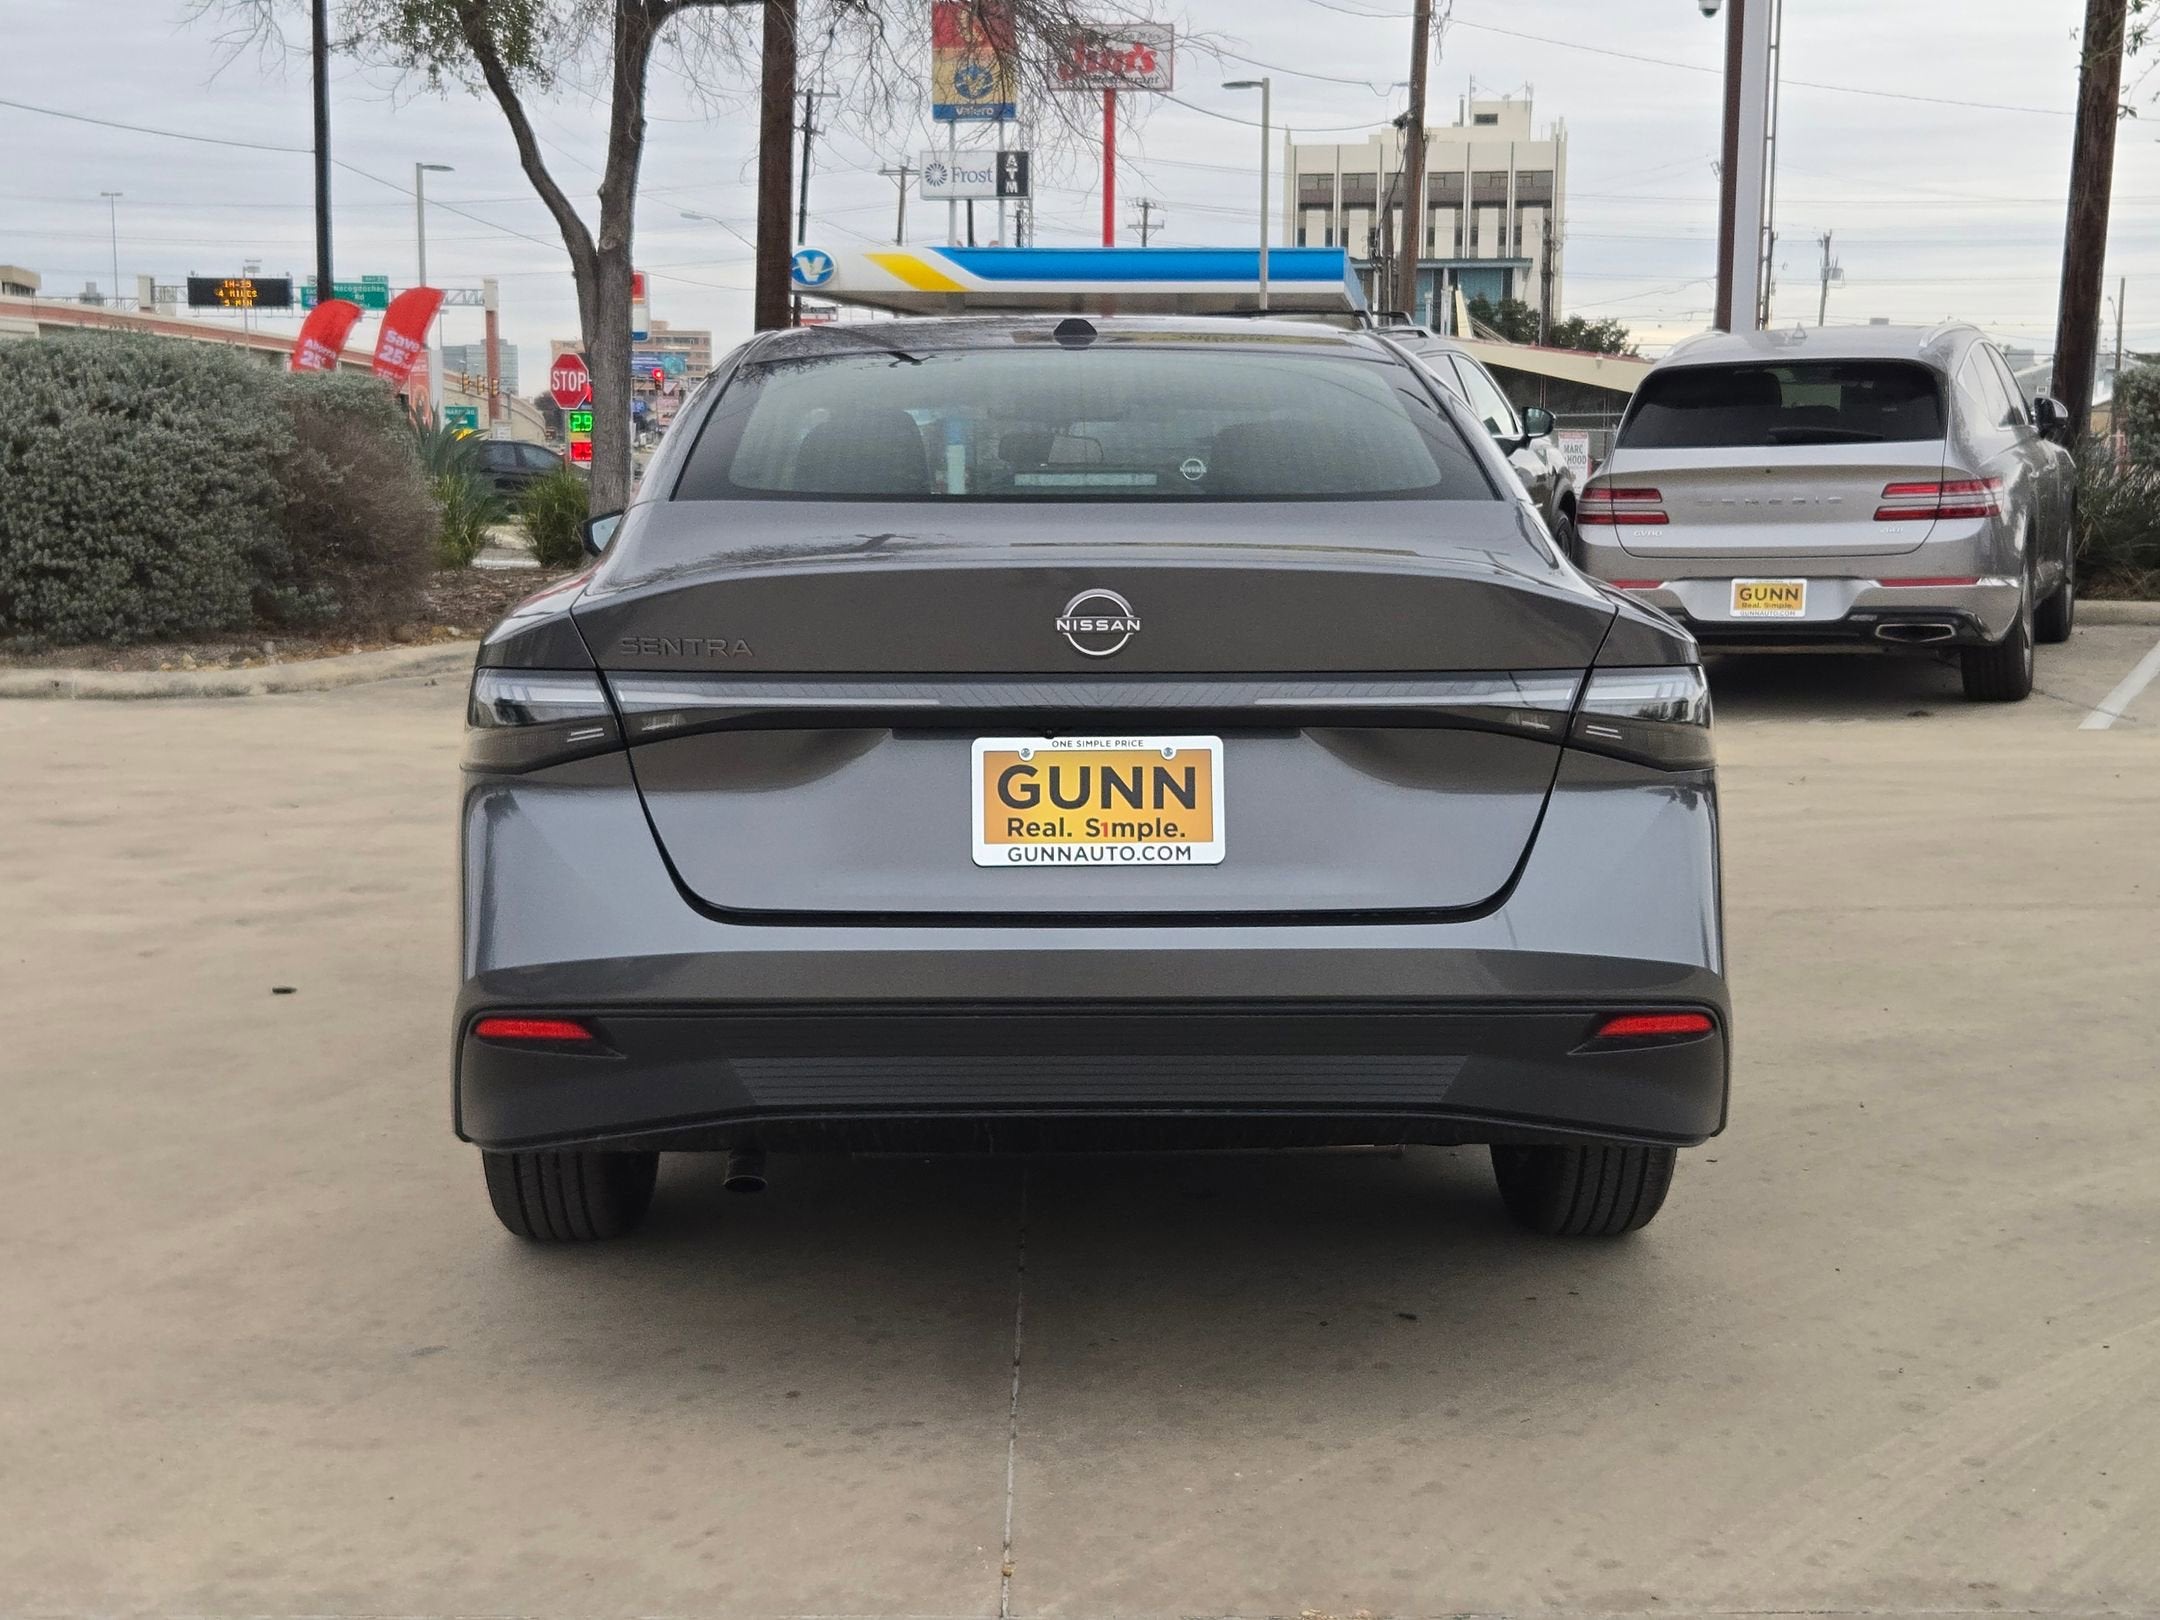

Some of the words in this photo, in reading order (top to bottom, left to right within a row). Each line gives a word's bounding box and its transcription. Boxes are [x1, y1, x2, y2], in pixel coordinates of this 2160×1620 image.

[951, 166, 993, 184] Frost
[1005, 154, 1019, 193] ATM
[384, 330, 420, 352] Save
[552, 371, 587, 392] STOP
[1740, 587, 1799, 601] GUNN
[1056, 619, 1140, 631] NISSAN
[620, 637, 754, 657] SENTRA
[1052, 739, 1073, 748] ONE
[1076, 739, 1111, 748] SIMPLE
[1115, 739, 1144, 748] PRICE
[997, 764, 1196, 810] GUNN
[1007, 817, 1073, 838] Real.
[1008, 846, 1191, 862] GUNNAUTO.COM
